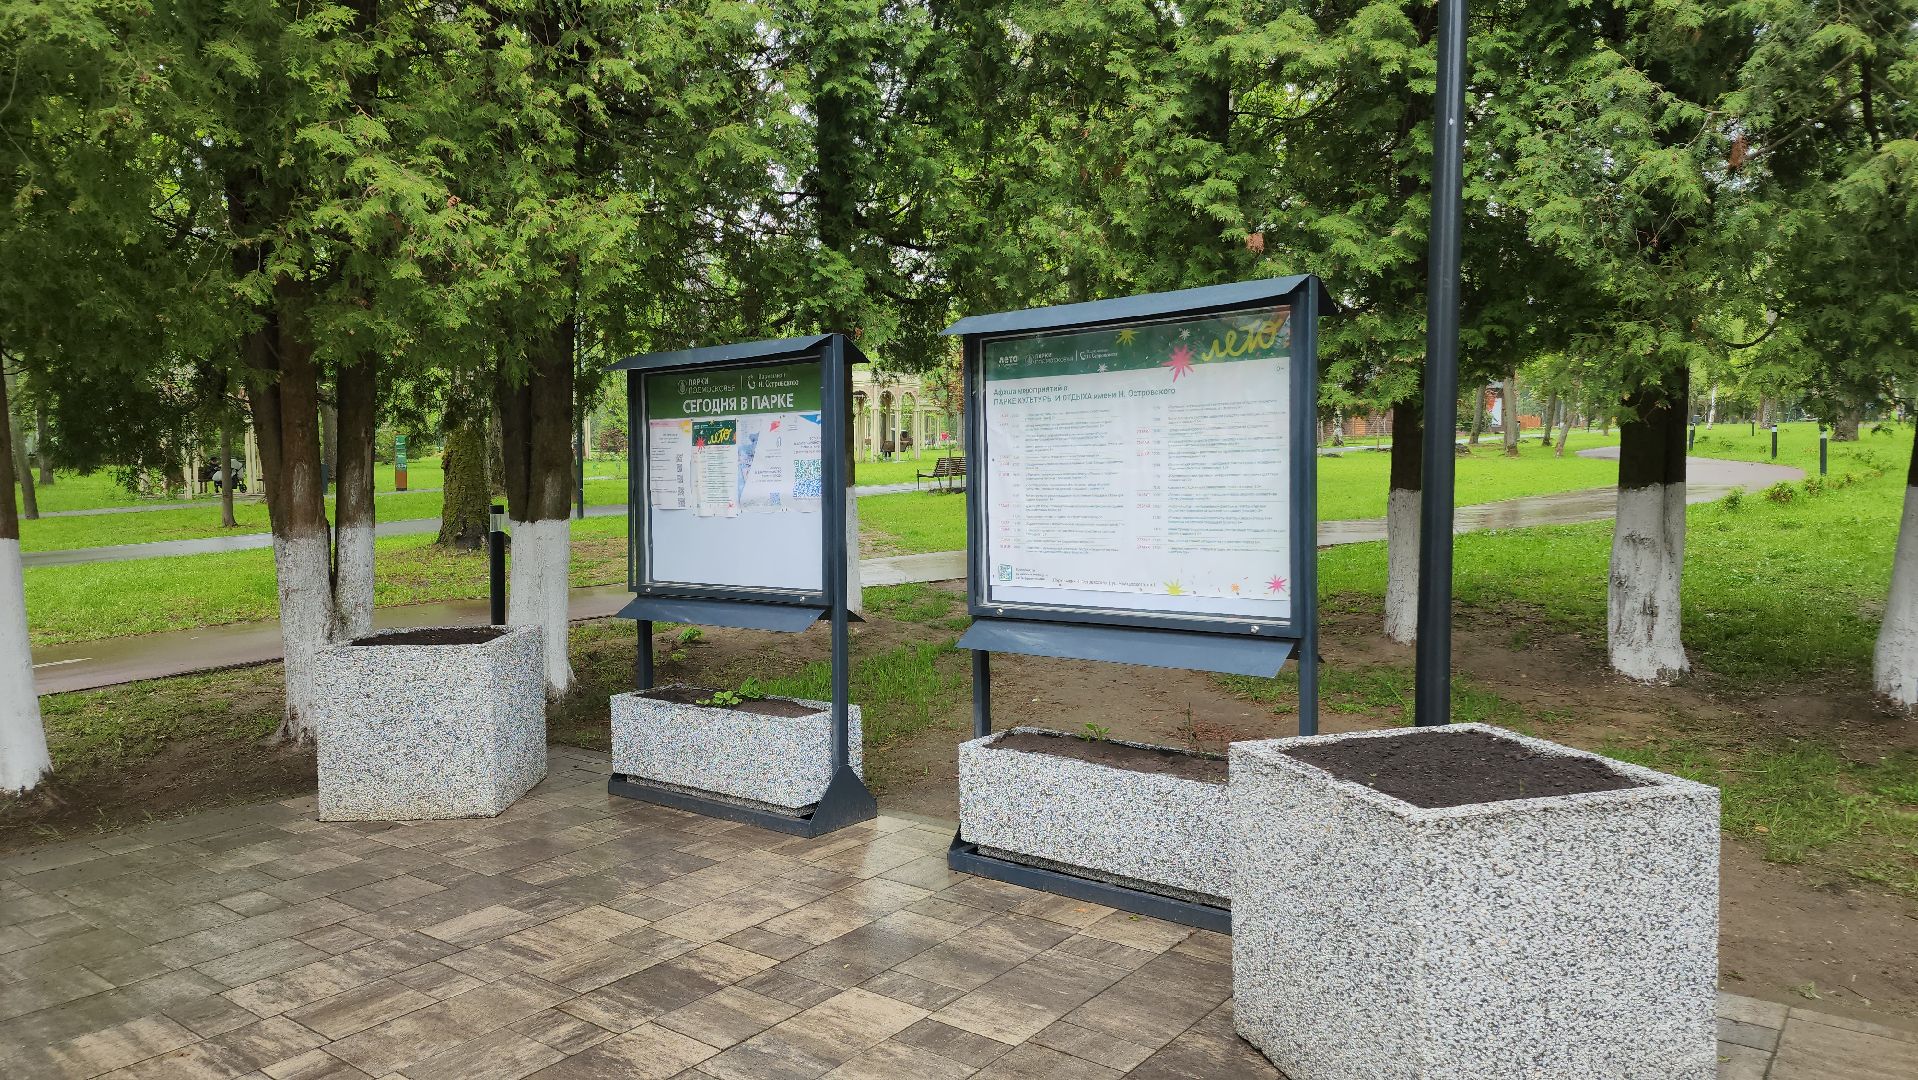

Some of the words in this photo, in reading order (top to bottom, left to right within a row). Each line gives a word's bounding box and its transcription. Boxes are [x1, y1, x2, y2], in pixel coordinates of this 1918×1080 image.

[688, 377, 709, 386] ПАРКИ
[993, 388, 1017, 397] Афиша
[1017, 385, 1063, 395] мероприятий
[993, 397, 1017, 405] ПАРКЕ
[1017, 395, 1052, 404] КУЛЬТУРЫ
[1055, 394, 1061, 402] И
[1062, 392, 1092, 402] ОТДЫХА
[1093, 392, 1117, 400] имени
[1128, 388, 1176, 399] Островского
[682, 396, 737, 414] СЕГОДНЯ
[740, 396, 748, 411] В
[751, 393, 794, 409] ПАРКЕ
